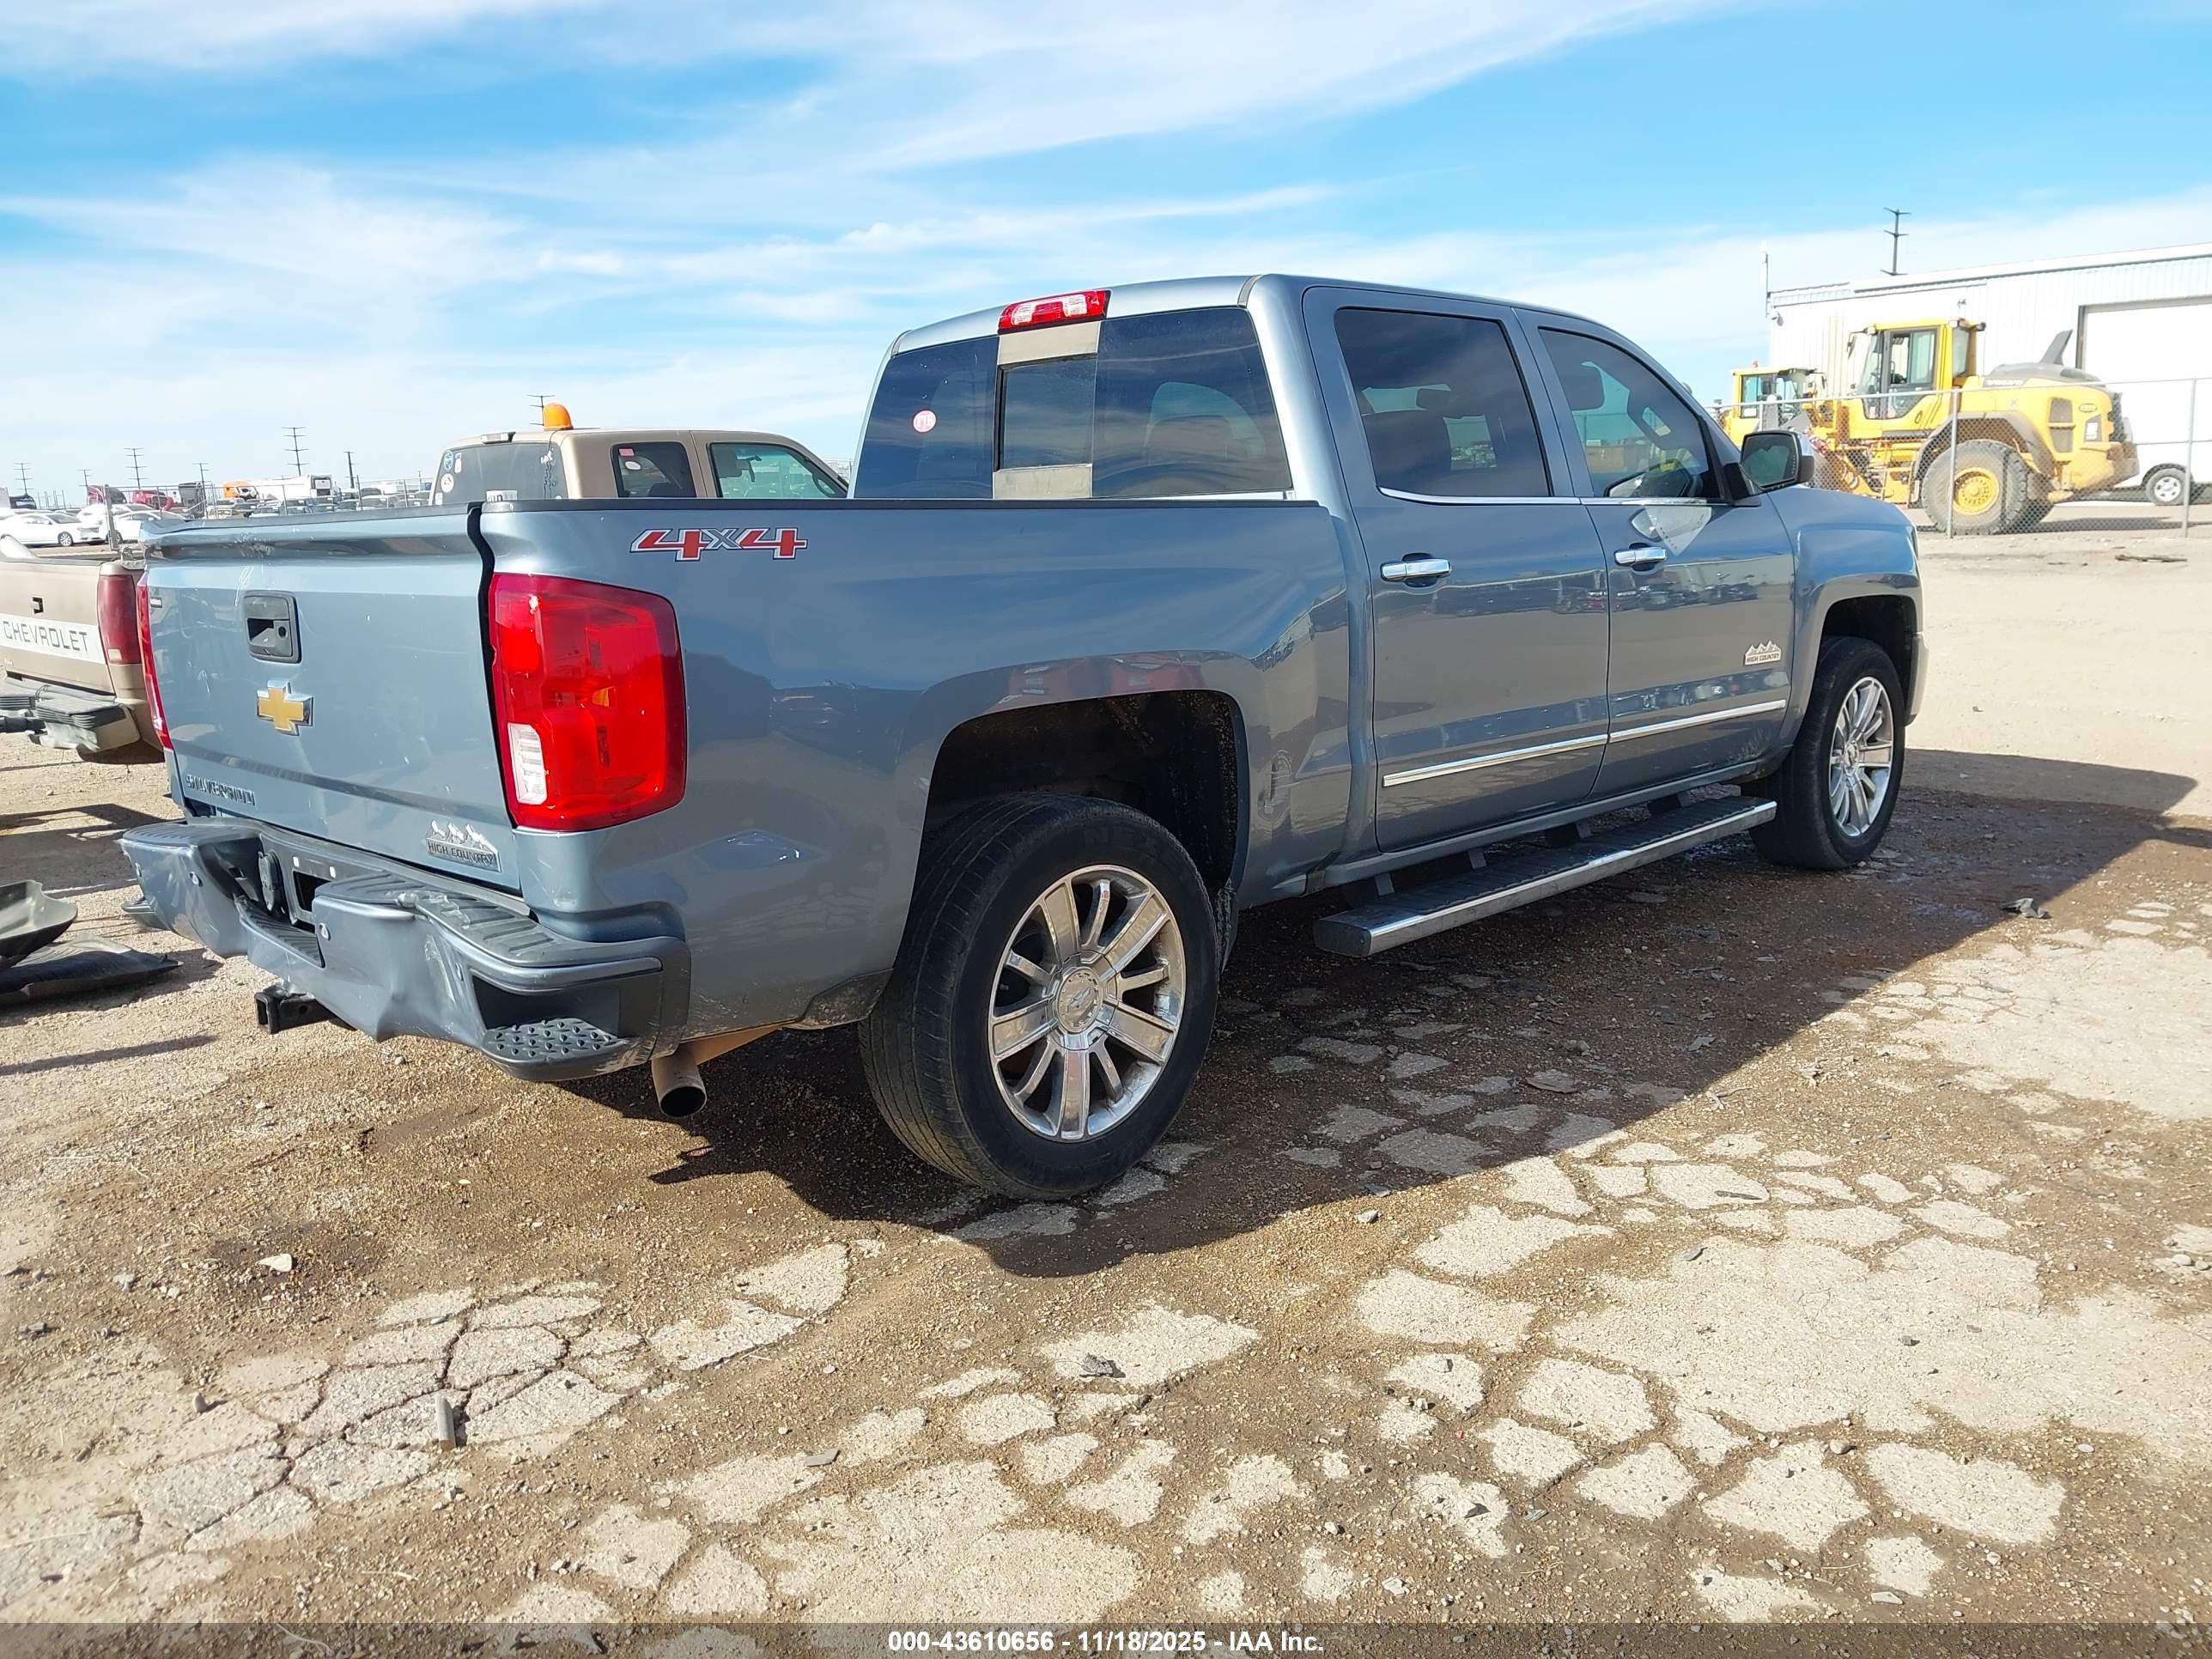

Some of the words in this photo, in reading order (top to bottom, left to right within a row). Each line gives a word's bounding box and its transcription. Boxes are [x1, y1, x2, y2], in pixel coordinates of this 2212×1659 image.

[3, 621, 88, 652] CHEVROLET
[428, 842, 448, 855] HIGH
[451, 848, 494, 866] COUNTRY
